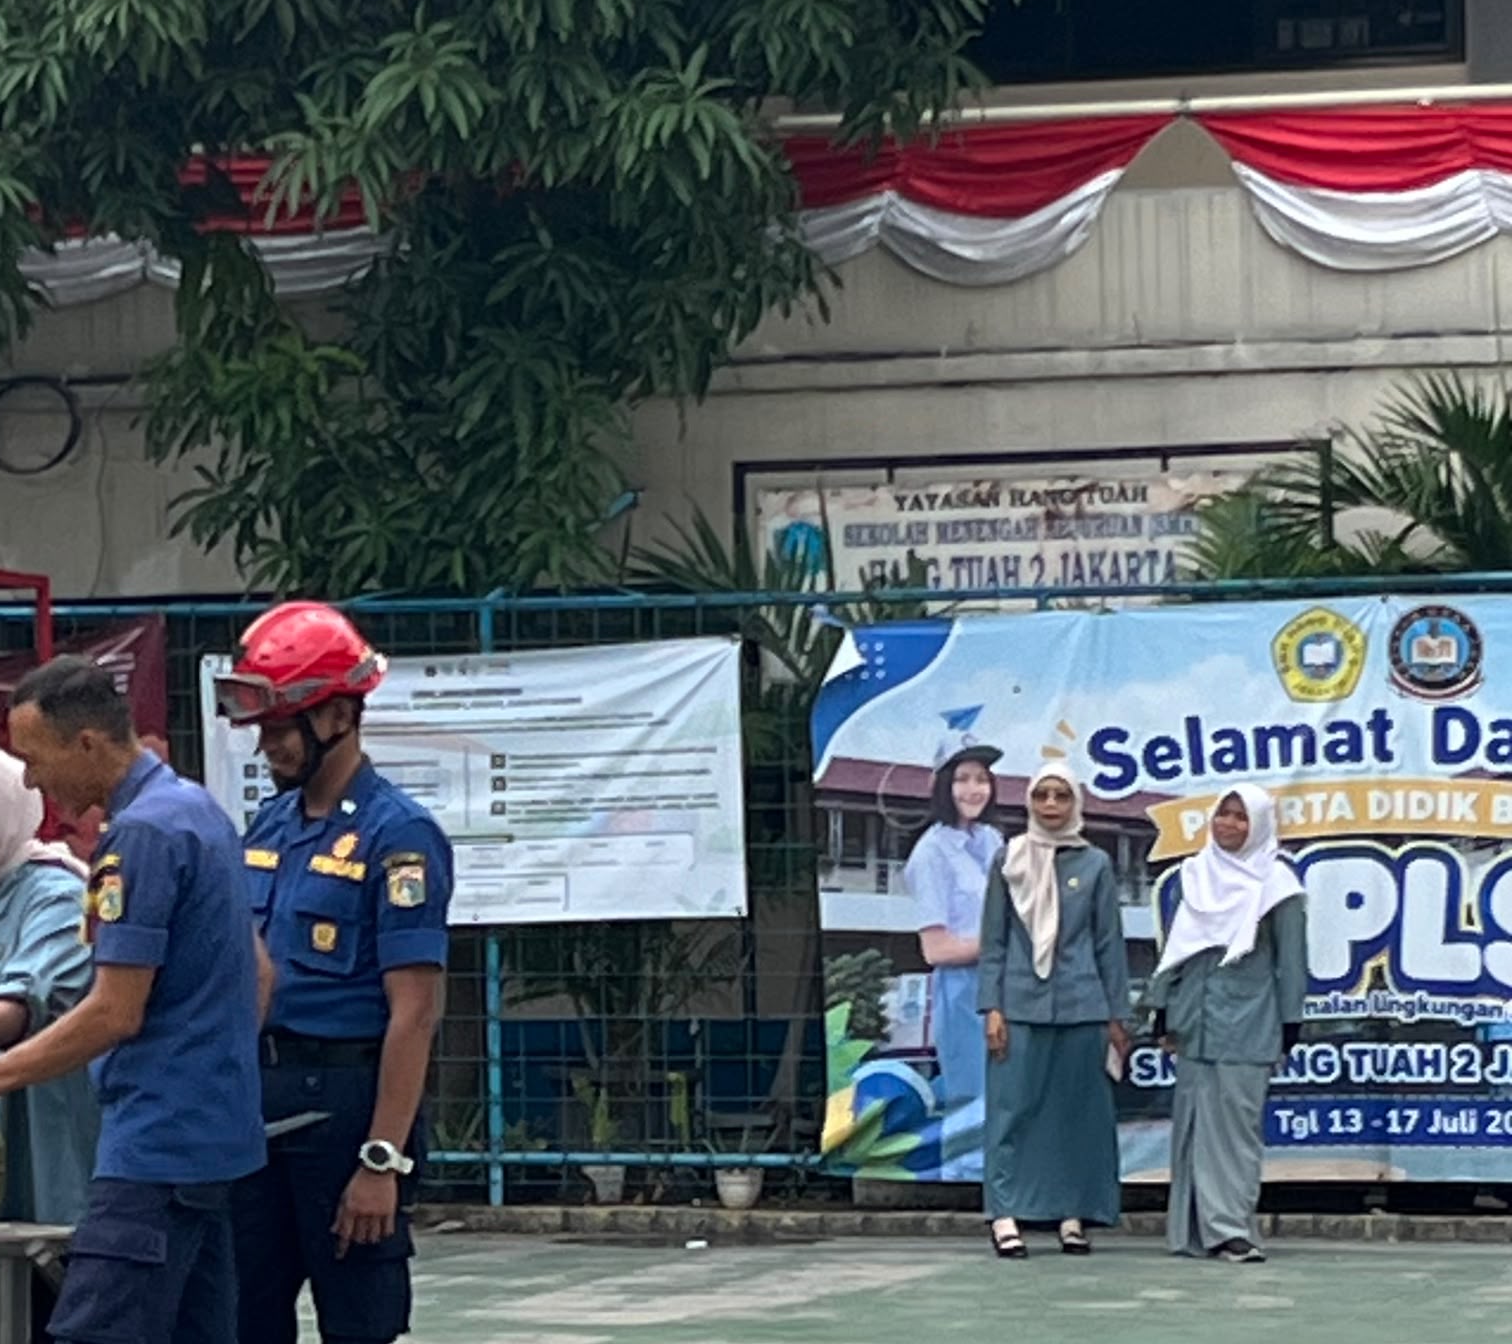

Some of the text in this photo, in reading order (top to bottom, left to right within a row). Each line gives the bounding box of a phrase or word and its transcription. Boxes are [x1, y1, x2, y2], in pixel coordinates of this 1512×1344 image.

[894, 488, 1000, 512] YAYASAN
[950, 555, 1022, 587] TUAH
[1030, 554, 1046, 586] 2
[1054, 549, 1177, 586] JAKARTA
[1087, 708, 1395, 791] Selamat
[1367, 790, 1478, 823] DIDIK
[1347, 1047, 1443, 1079] TUAH
[1454, 1048, 1478, 1078] 2
[1274, 1109, 1320, 1140] Tgl
[1328, 1109, 1364, 1133] 13
[1387, 1109, 1419, 1133] 17
[1427, 1108, 1478, 1135] Juli
